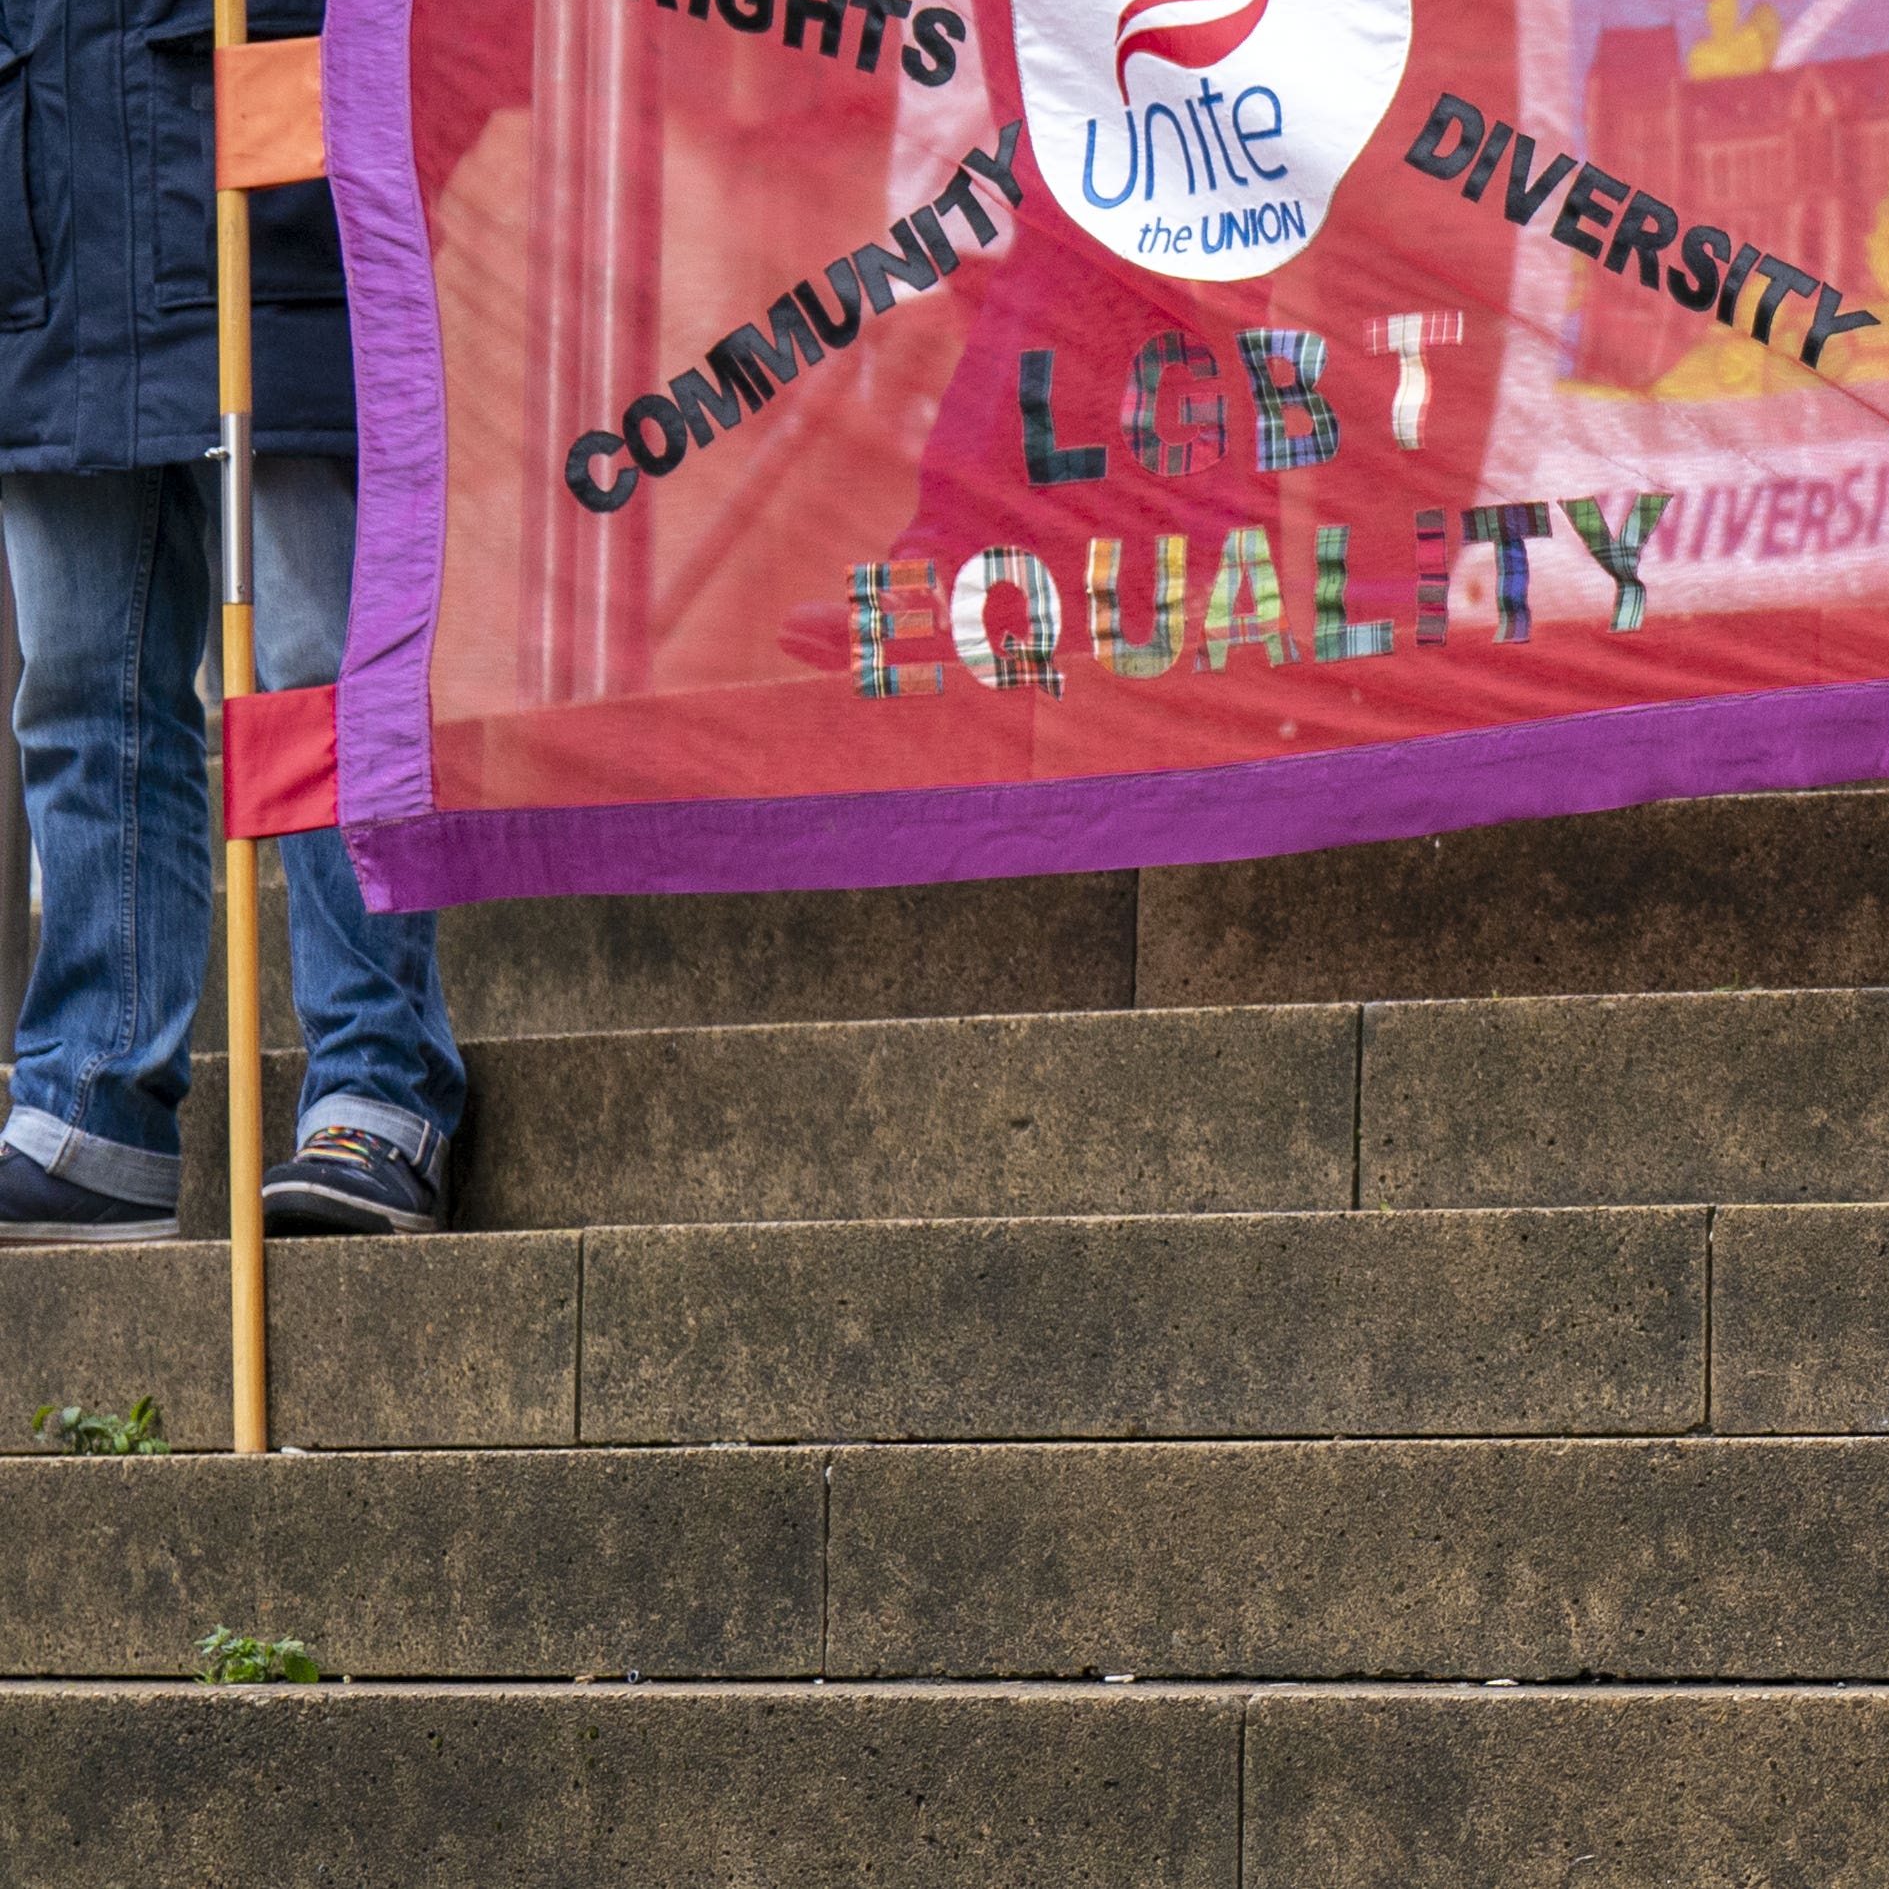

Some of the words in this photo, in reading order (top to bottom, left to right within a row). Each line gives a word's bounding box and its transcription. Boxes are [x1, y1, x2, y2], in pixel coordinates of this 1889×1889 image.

[565, 118, 1023, 514] COMMUNITY
[1137, 216, 1193, 254] the
[1202, 200, 1306, 254] UNION
[1404, 91, 1881, 370] DIVERSITY
[844, 492, 1673, 701] EQUALITY
